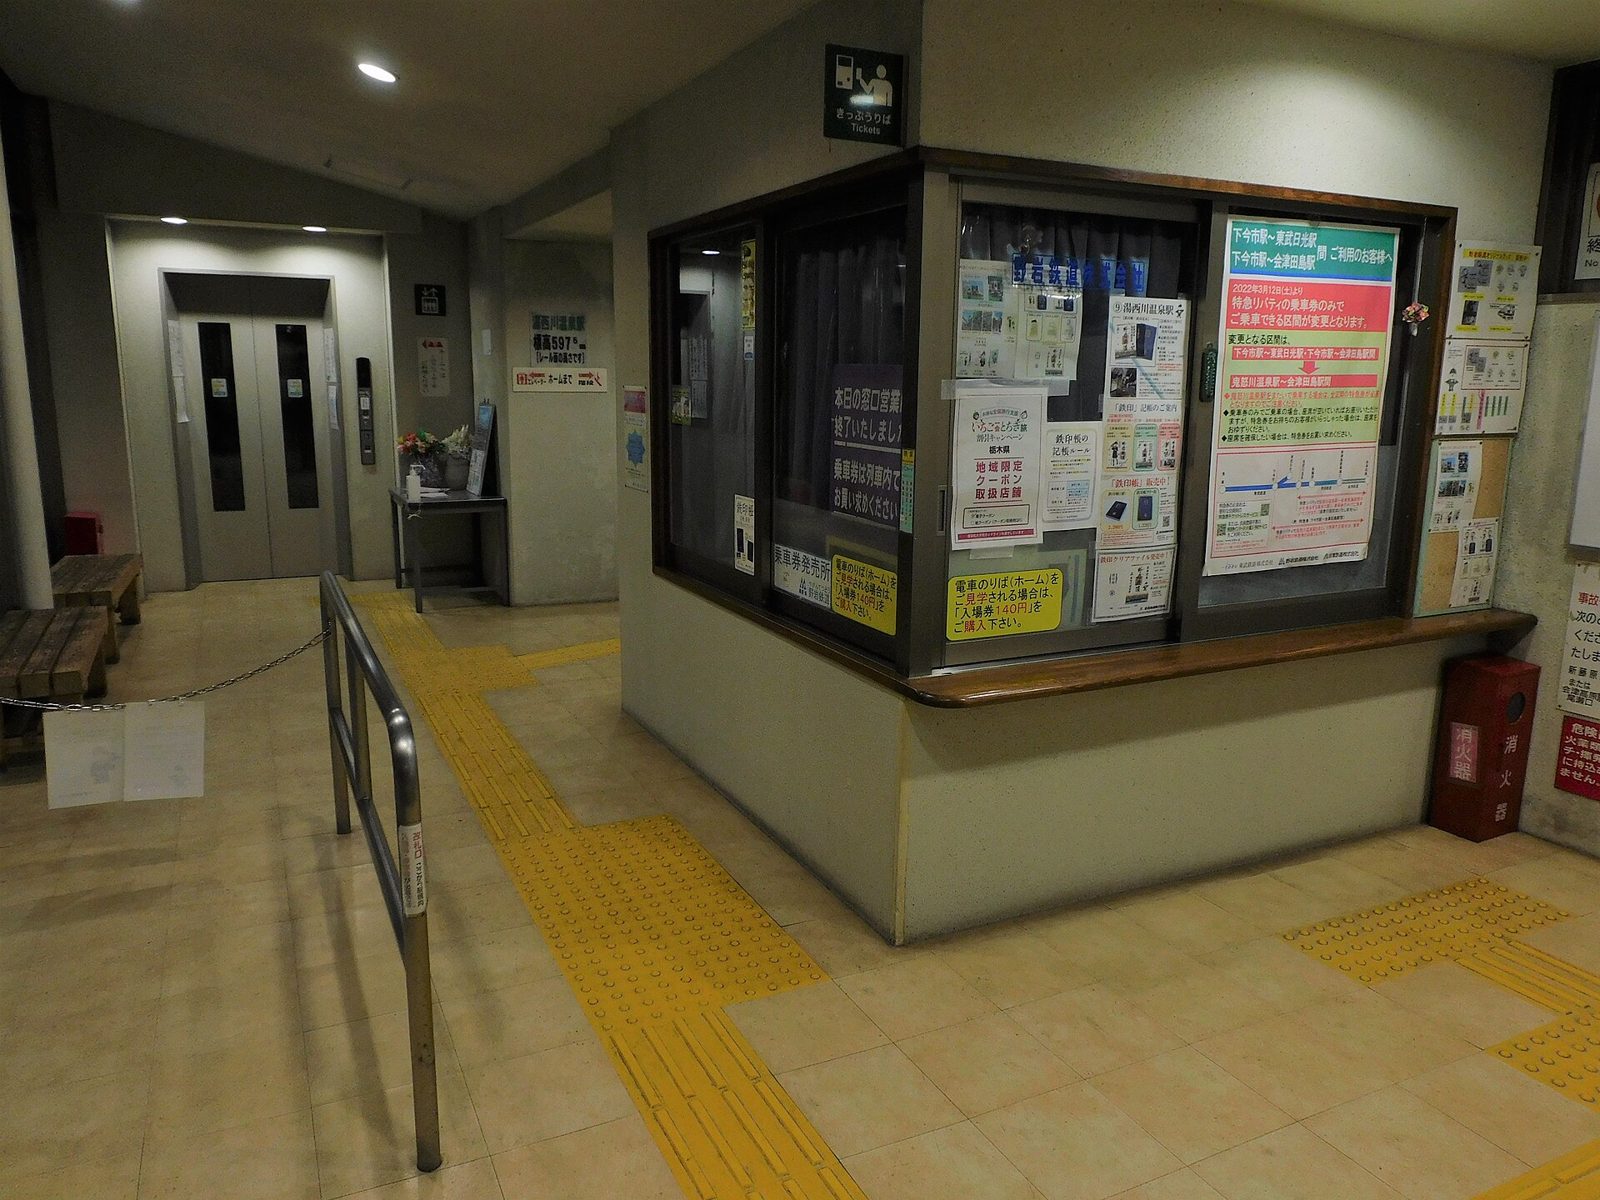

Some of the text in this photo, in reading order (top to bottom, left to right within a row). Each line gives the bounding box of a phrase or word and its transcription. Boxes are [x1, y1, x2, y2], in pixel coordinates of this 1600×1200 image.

[836, 108, 892, 126] きっぷうりば
[851, 122, 881, 136] Tickets
[1330, 245, 1393, 265] ご利用のお客様へ
[1232, 296, 1345, 312] 特急リバティの乗車券のみで
[1231, 313, 1368, 329] ご乗車できる区間が変更となります。
[834, 387, 902, 414] 本日の窓口営業
[975, 460, 1023, 473] 地域限定
[975, 473, 1022, 486] クーポン
[975, 486, 1022, 500] 取扱店舗
[955, 573, 1059, 594] 電車のりば（ホーム）を
[954, 587, 1055, 606] ご見学される場合は、
[1578, 591, 1600, 607] 事故
[954, 601, 1043, 619] 「入場券140円」を
[954, 616, 1023, 634] ご購入下さい。
[1568, 665, 1600, 683] 新藤原
[1571, 722, 1600, 741] 危険
[1454, 726, 1473, 781] 消火器
[1495, 734, 1519, 823] 消火器
